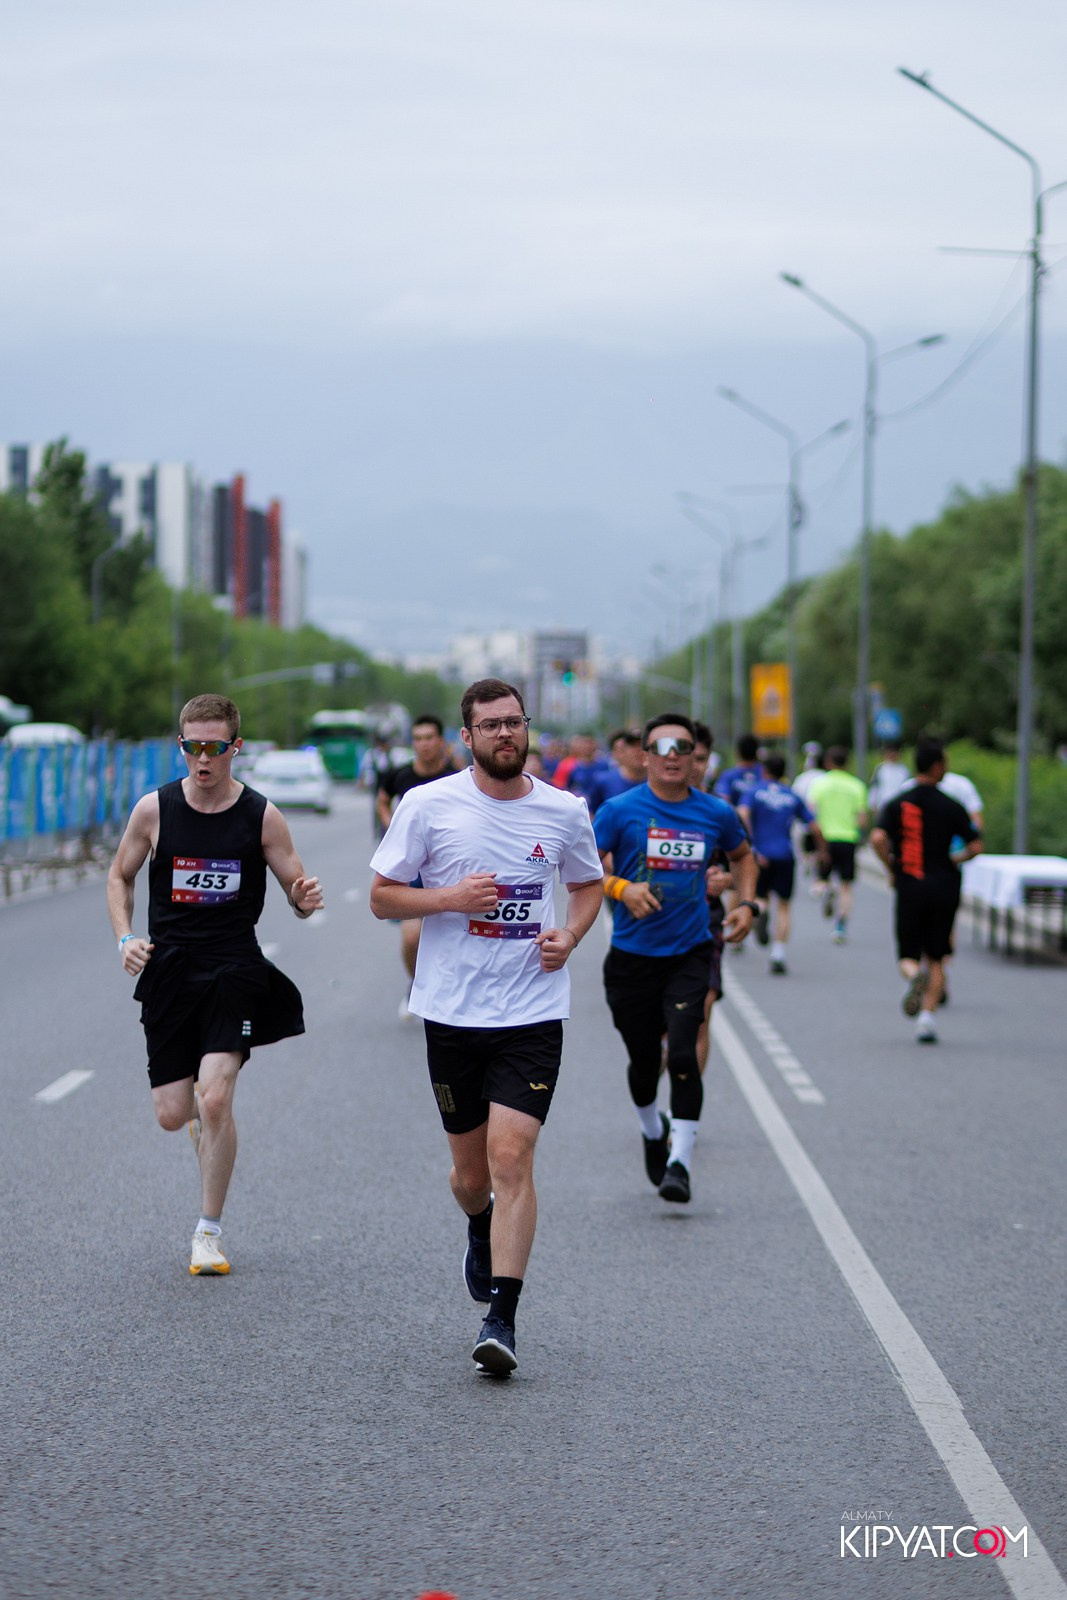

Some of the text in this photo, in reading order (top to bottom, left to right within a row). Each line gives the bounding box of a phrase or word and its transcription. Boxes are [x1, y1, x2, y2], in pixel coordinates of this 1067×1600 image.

[659, 842, 694, 857] 053
[525, 856, 549, 864] AKRA
[185, 873, 229, 889] 453
